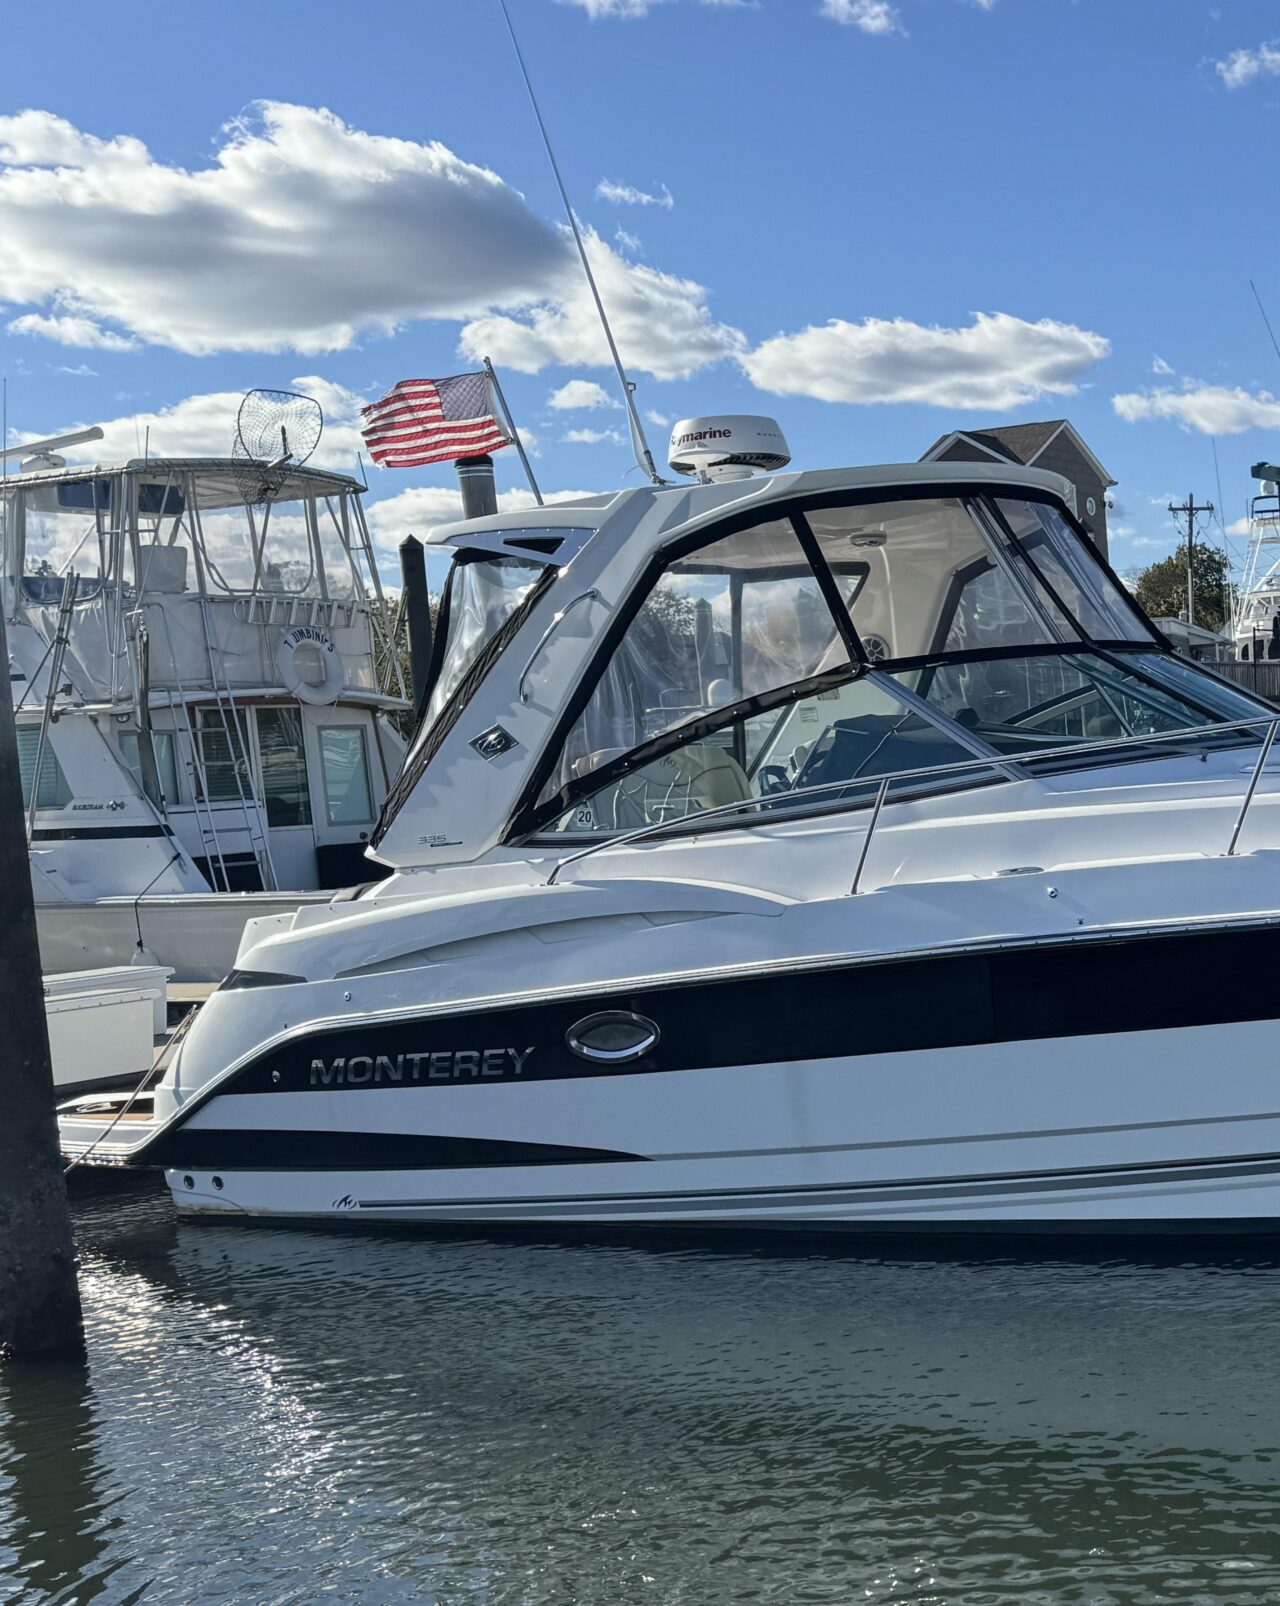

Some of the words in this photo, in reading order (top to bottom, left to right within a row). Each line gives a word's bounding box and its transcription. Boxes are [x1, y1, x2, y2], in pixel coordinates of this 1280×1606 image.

[671, 427, 732, 446] ymarine
[578, 810, 592, 823] 20
[310, 1046, 536, 1085] MONTEREY
